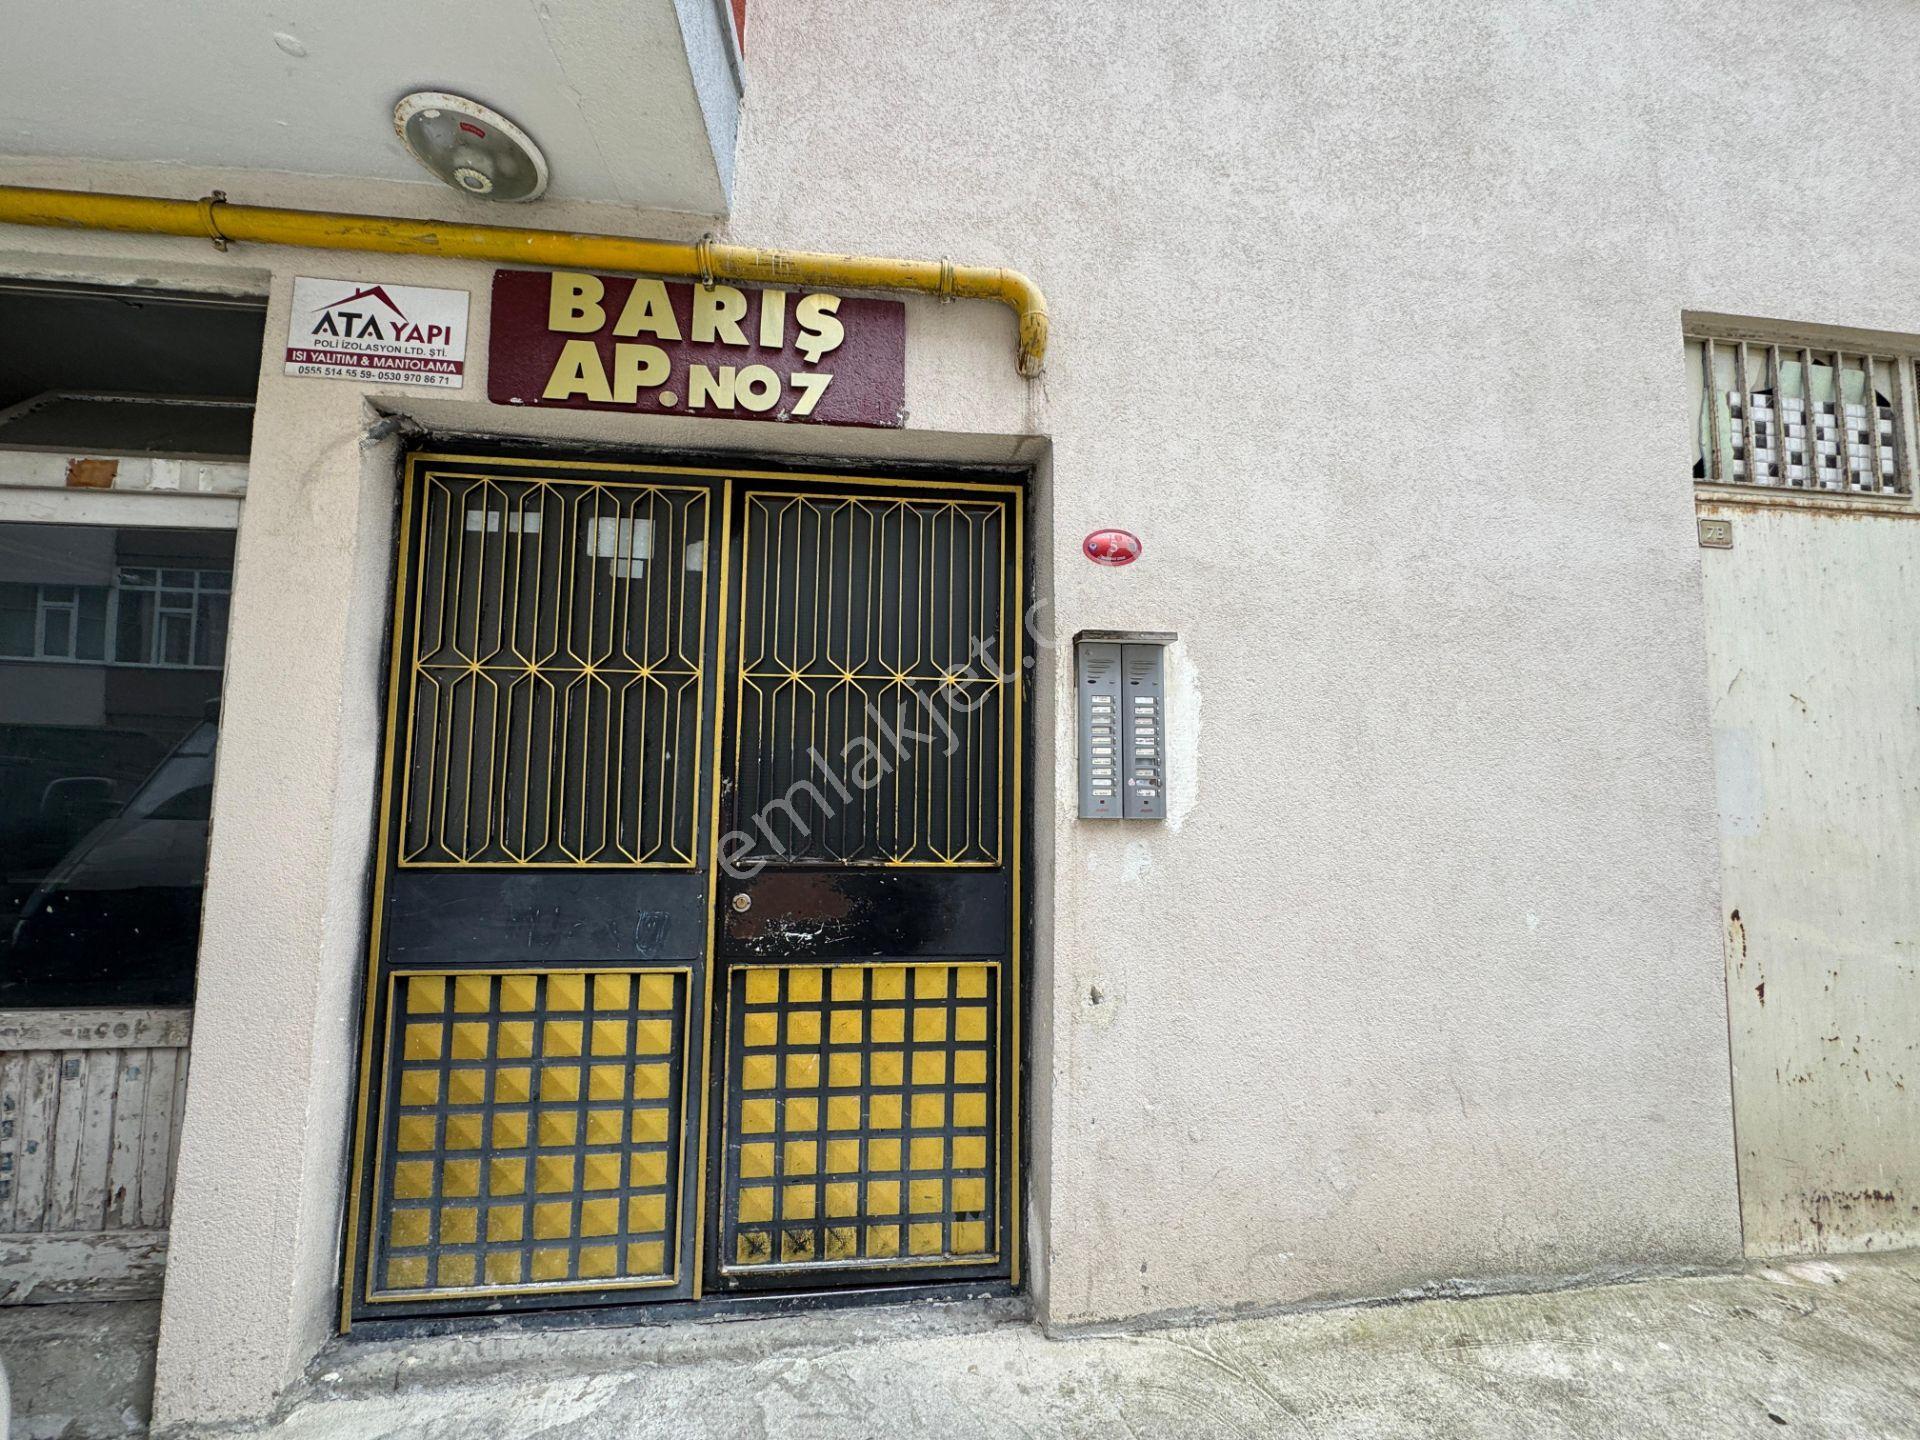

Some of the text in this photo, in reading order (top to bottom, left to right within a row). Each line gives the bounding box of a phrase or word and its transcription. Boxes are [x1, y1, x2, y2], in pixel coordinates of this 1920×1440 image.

[547, 271, 846, 364] BARIŞ
[314, 339, 448, 357] POLİ İZOLASYON LTD. ŞTİ.
[292, 350, 457, 373] ISI YALITIM & MANTOLAMA
[324, 367, 342, 376] 514
[378, 371, 401, 381] 0530
[404, 373, 422, 383] 970
